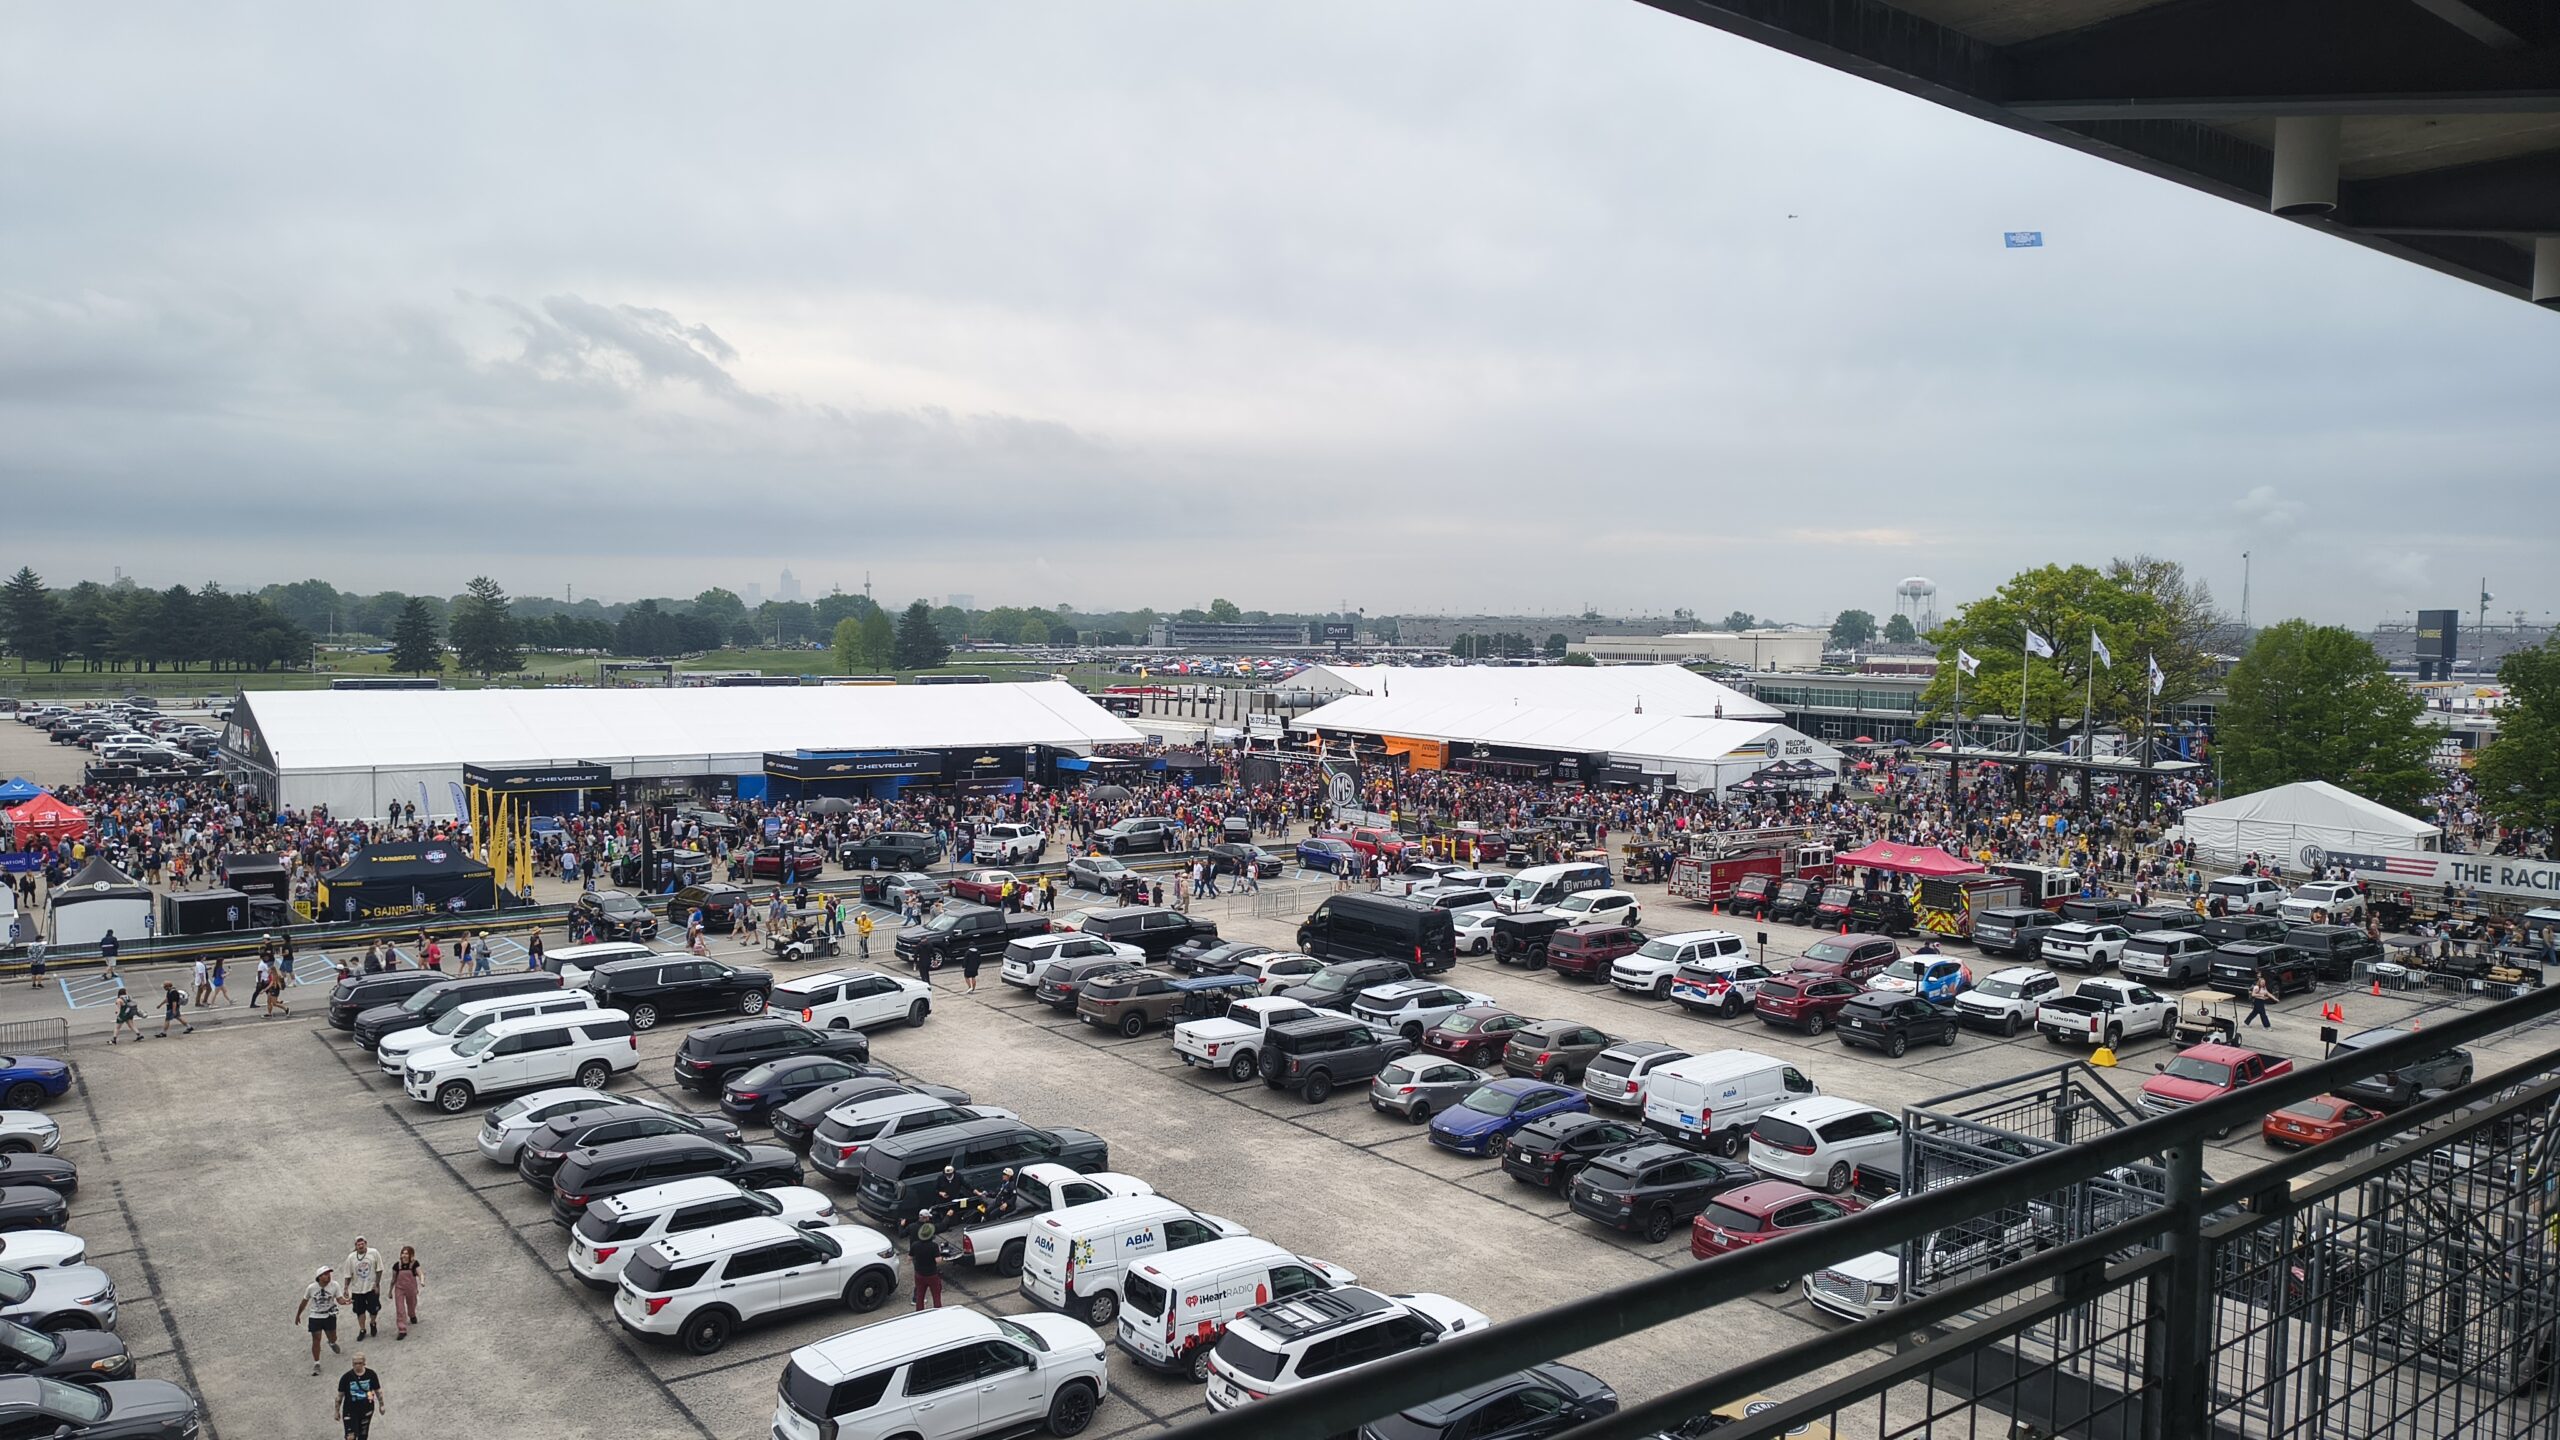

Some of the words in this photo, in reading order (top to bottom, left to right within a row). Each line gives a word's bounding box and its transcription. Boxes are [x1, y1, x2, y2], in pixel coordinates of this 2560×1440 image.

[1785, 747, 1799, 755] RACE
[1800, 746, 1813, 754] FANS
[856, 762, 919, 770] CHEVROLET
[535, 775, 600, 783] CHEVROLET
[1332, 776, 1352, 801] IMS
[379, 854, 417, 862] GAINBRIDGE
[2451, 862, 2492, 884] THE
[1572, 880, 1593, 889] WTHR
[373, 903, 437, 917] GAINBRDGE
[2049, 1014, 2079, 1024] TUNDRA
[1722, 1088, 1737, 1099] ABM
[1034, 1235, 1054, 1253] ABM
[1125, 1232, 1154, 1247] ABM
[1199, 1283, 1254, 1304] iHeartRADIO
